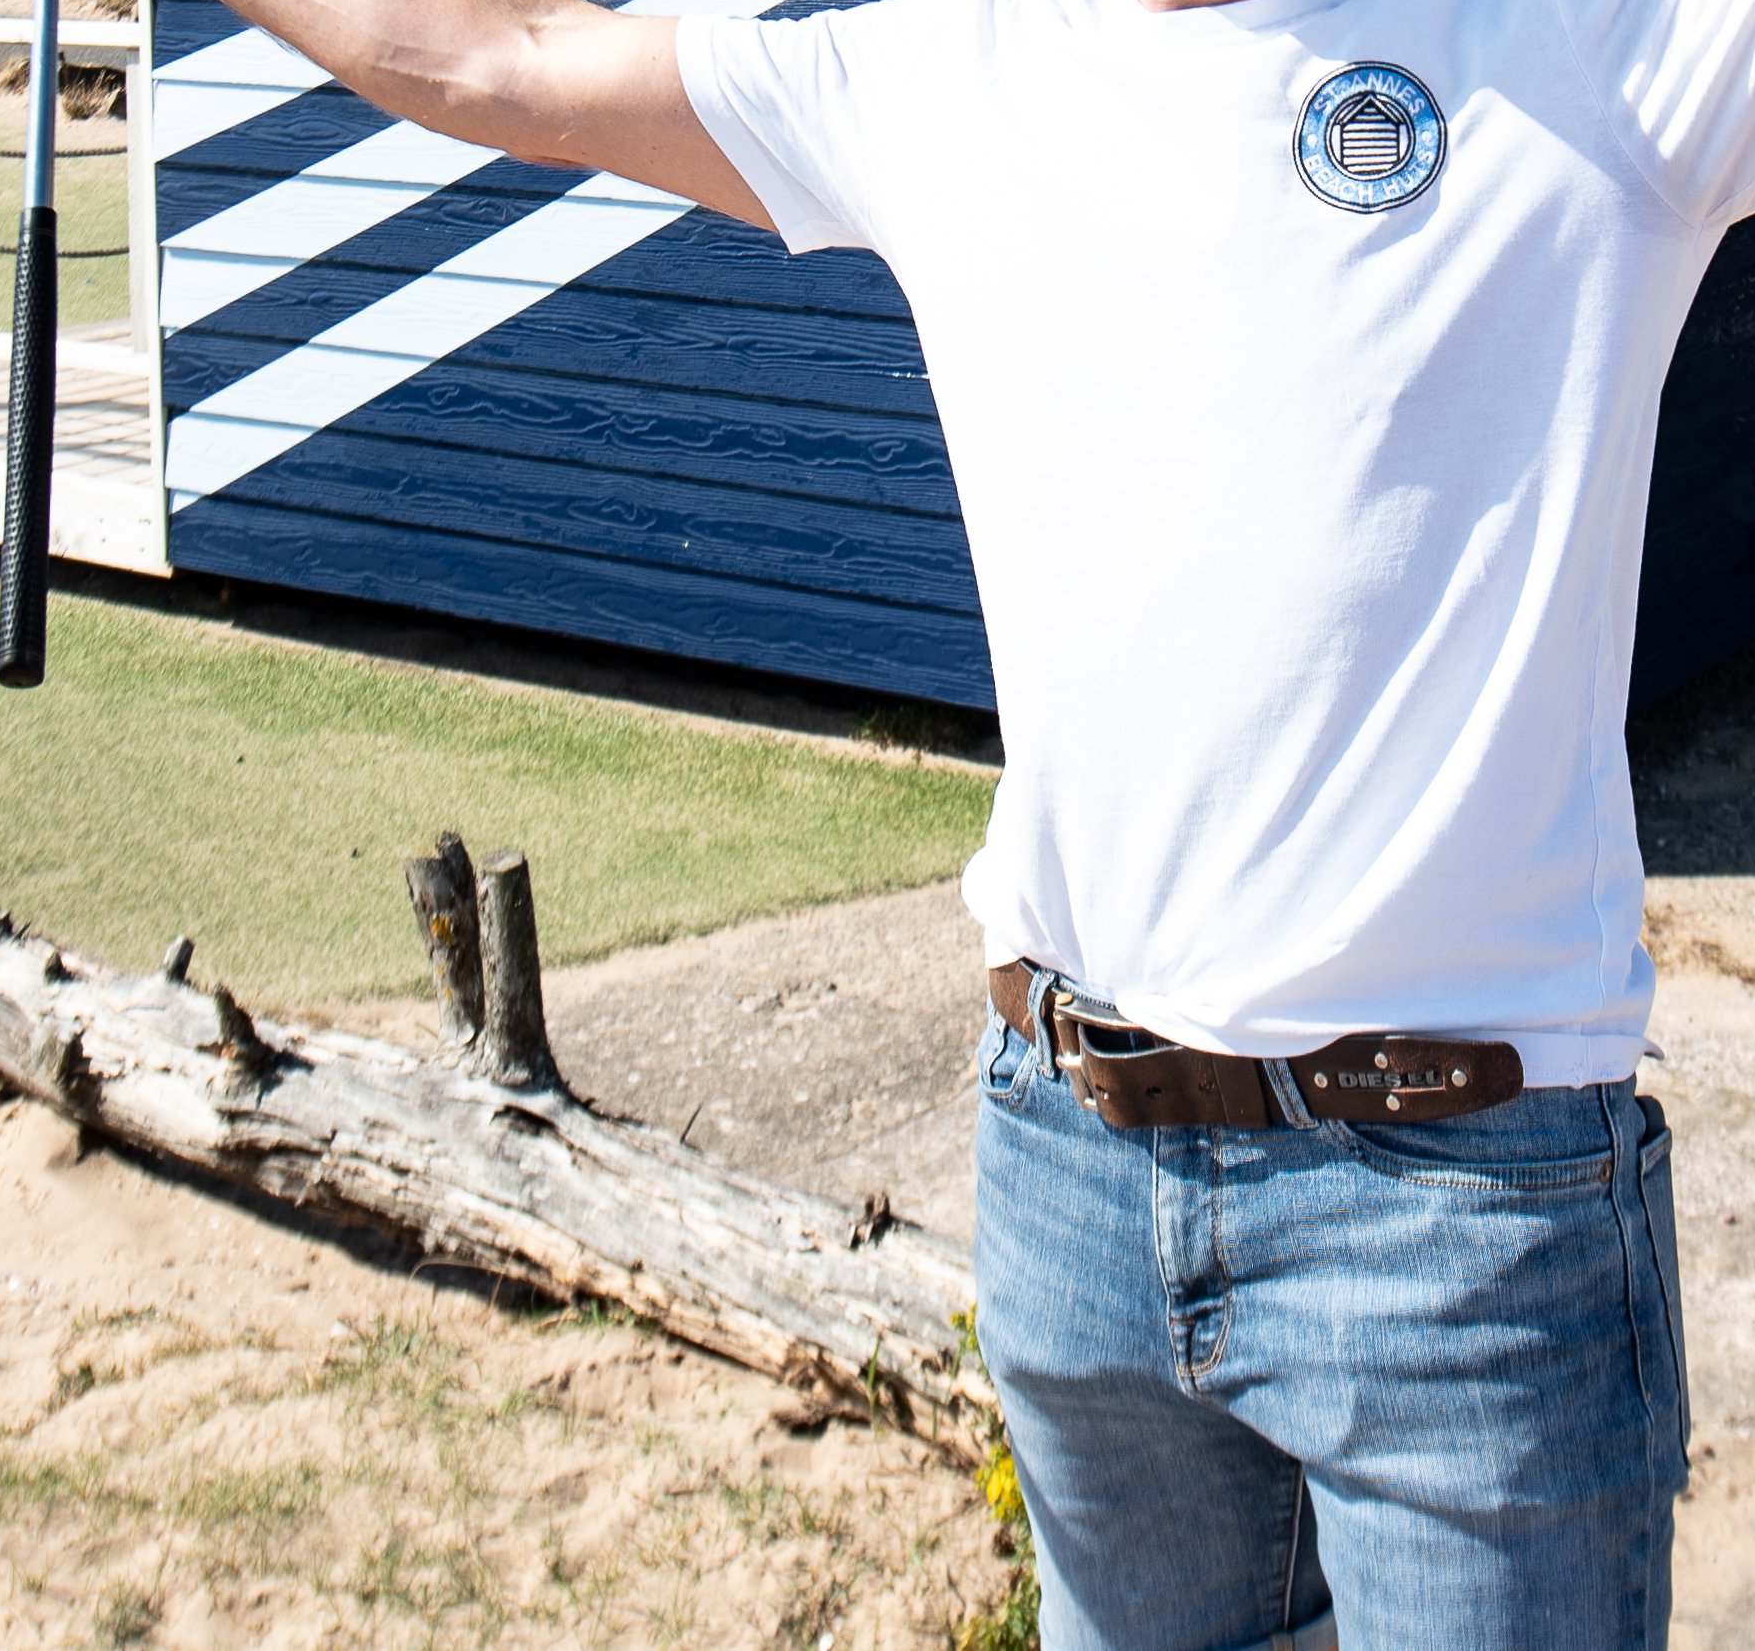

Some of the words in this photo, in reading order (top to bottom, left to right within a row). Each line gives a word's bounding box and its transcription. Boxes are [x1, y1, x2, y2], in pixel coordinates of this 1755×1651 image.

[1350, 71, 1426, 115] ANNES
[1303, 153, 1374, 205] BEACH
[1381, 150, 1436, 197] HUTS
[1337, 1069, 1443, 1089] DIESEL
